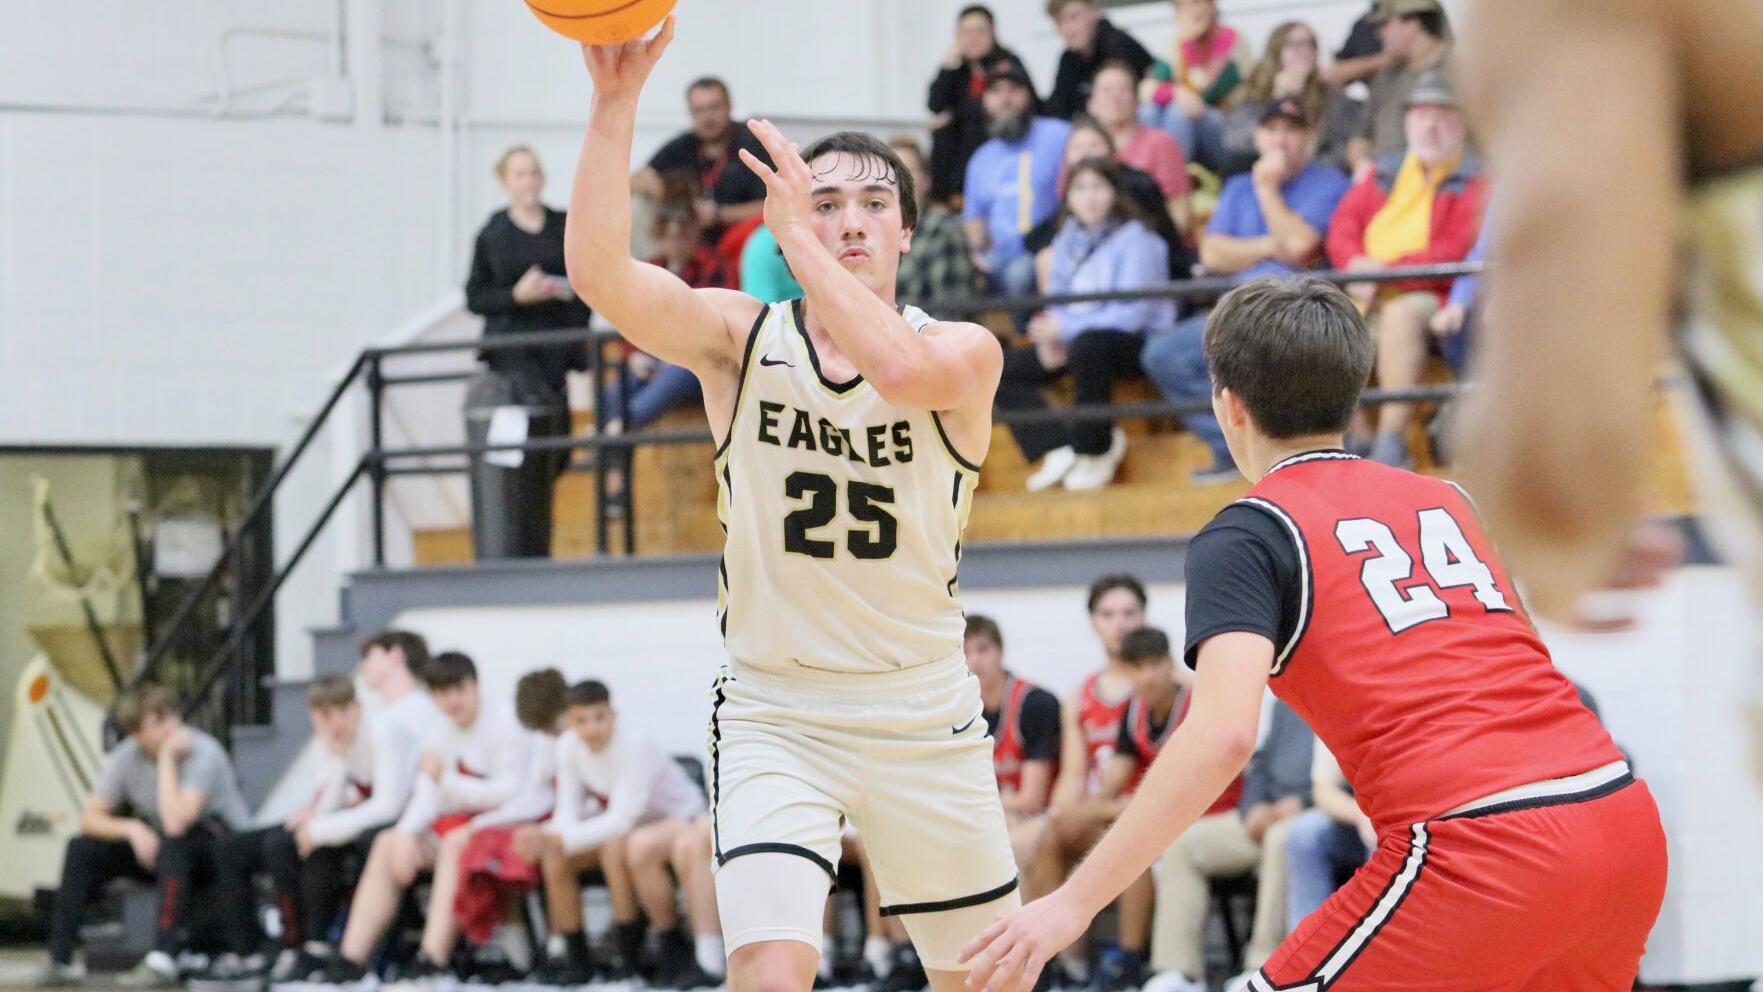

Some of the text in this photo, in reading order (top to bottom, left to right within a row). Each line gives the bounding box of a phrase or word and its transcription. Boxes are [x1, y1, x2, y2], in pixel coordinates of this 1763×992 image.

[758, 400, 914, 467] EAGLES
[784, 471, 898, 559] 25
[1333, 506, 1515, 636] 24
